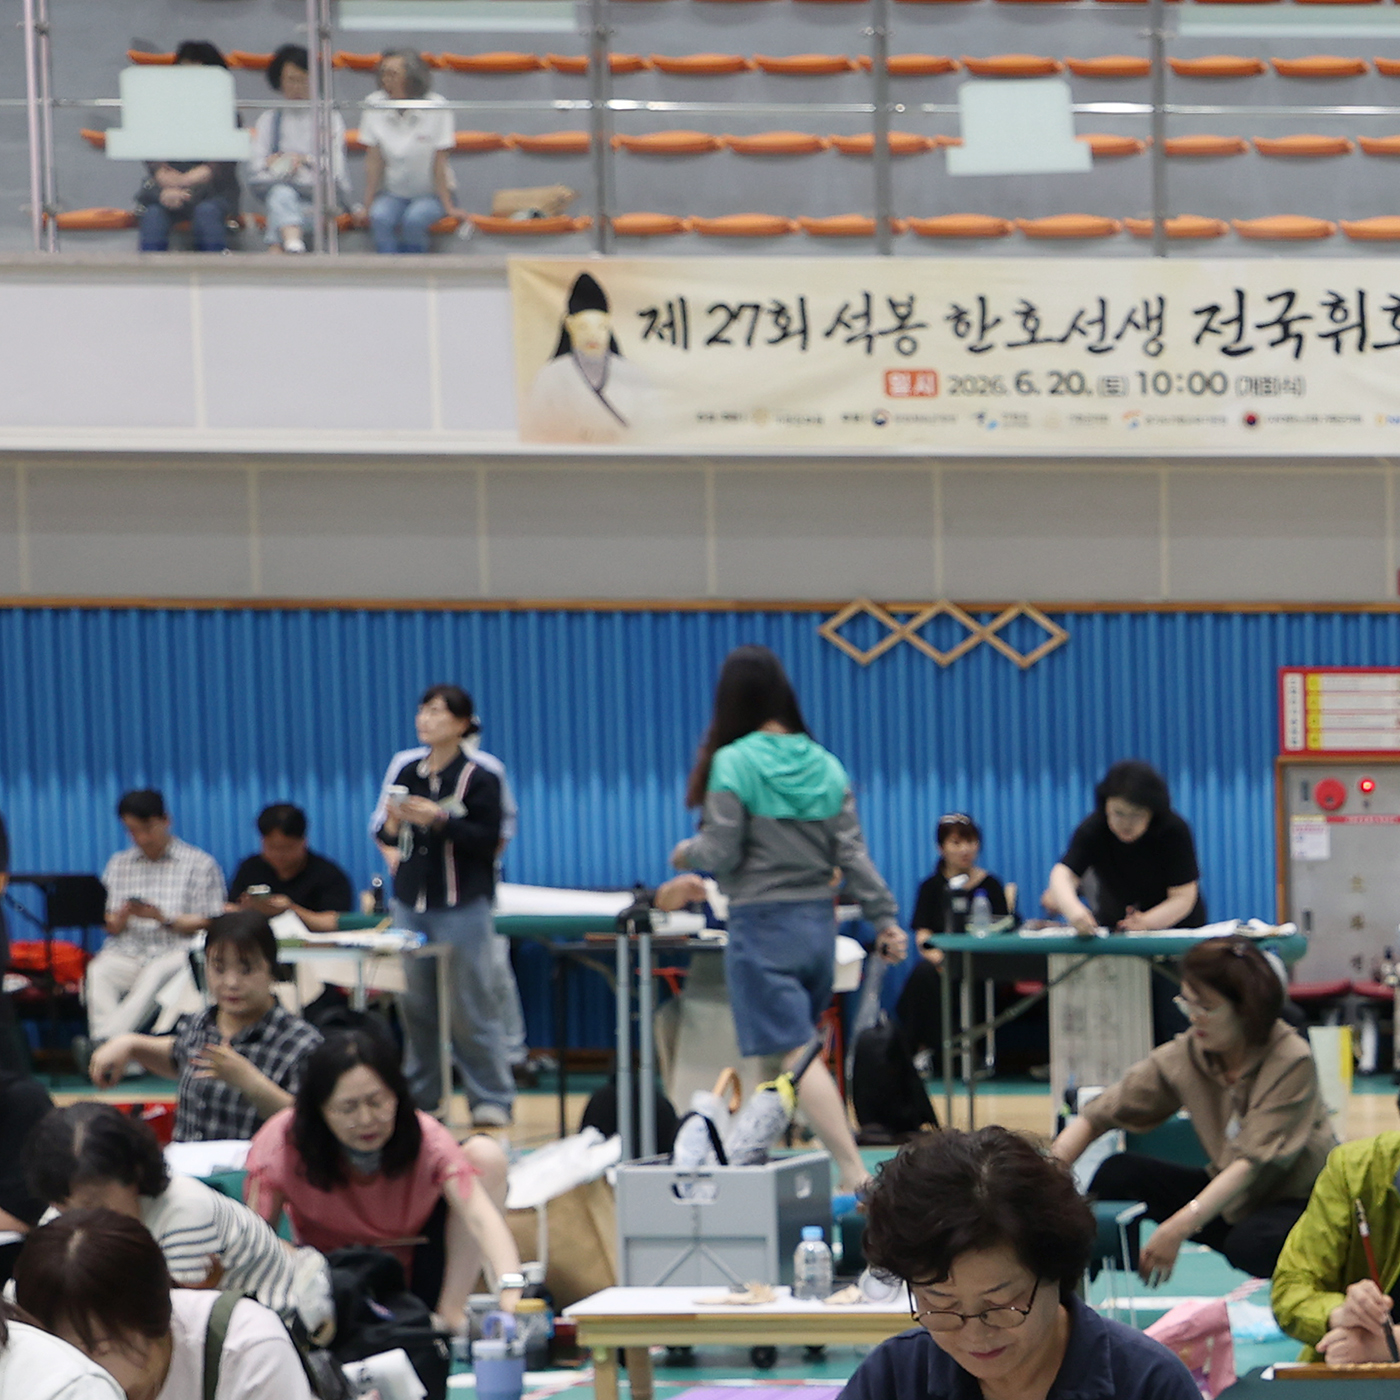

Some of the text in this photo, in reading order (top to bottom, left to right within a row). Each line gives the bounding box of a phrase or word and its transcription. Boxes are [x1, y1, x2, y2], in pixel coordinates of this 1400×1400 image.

[824, 290, 927, 358] 석봉
[944, 294, 1167, 359] 한호선생
[1138, 370, 1229, 396] 10:00
